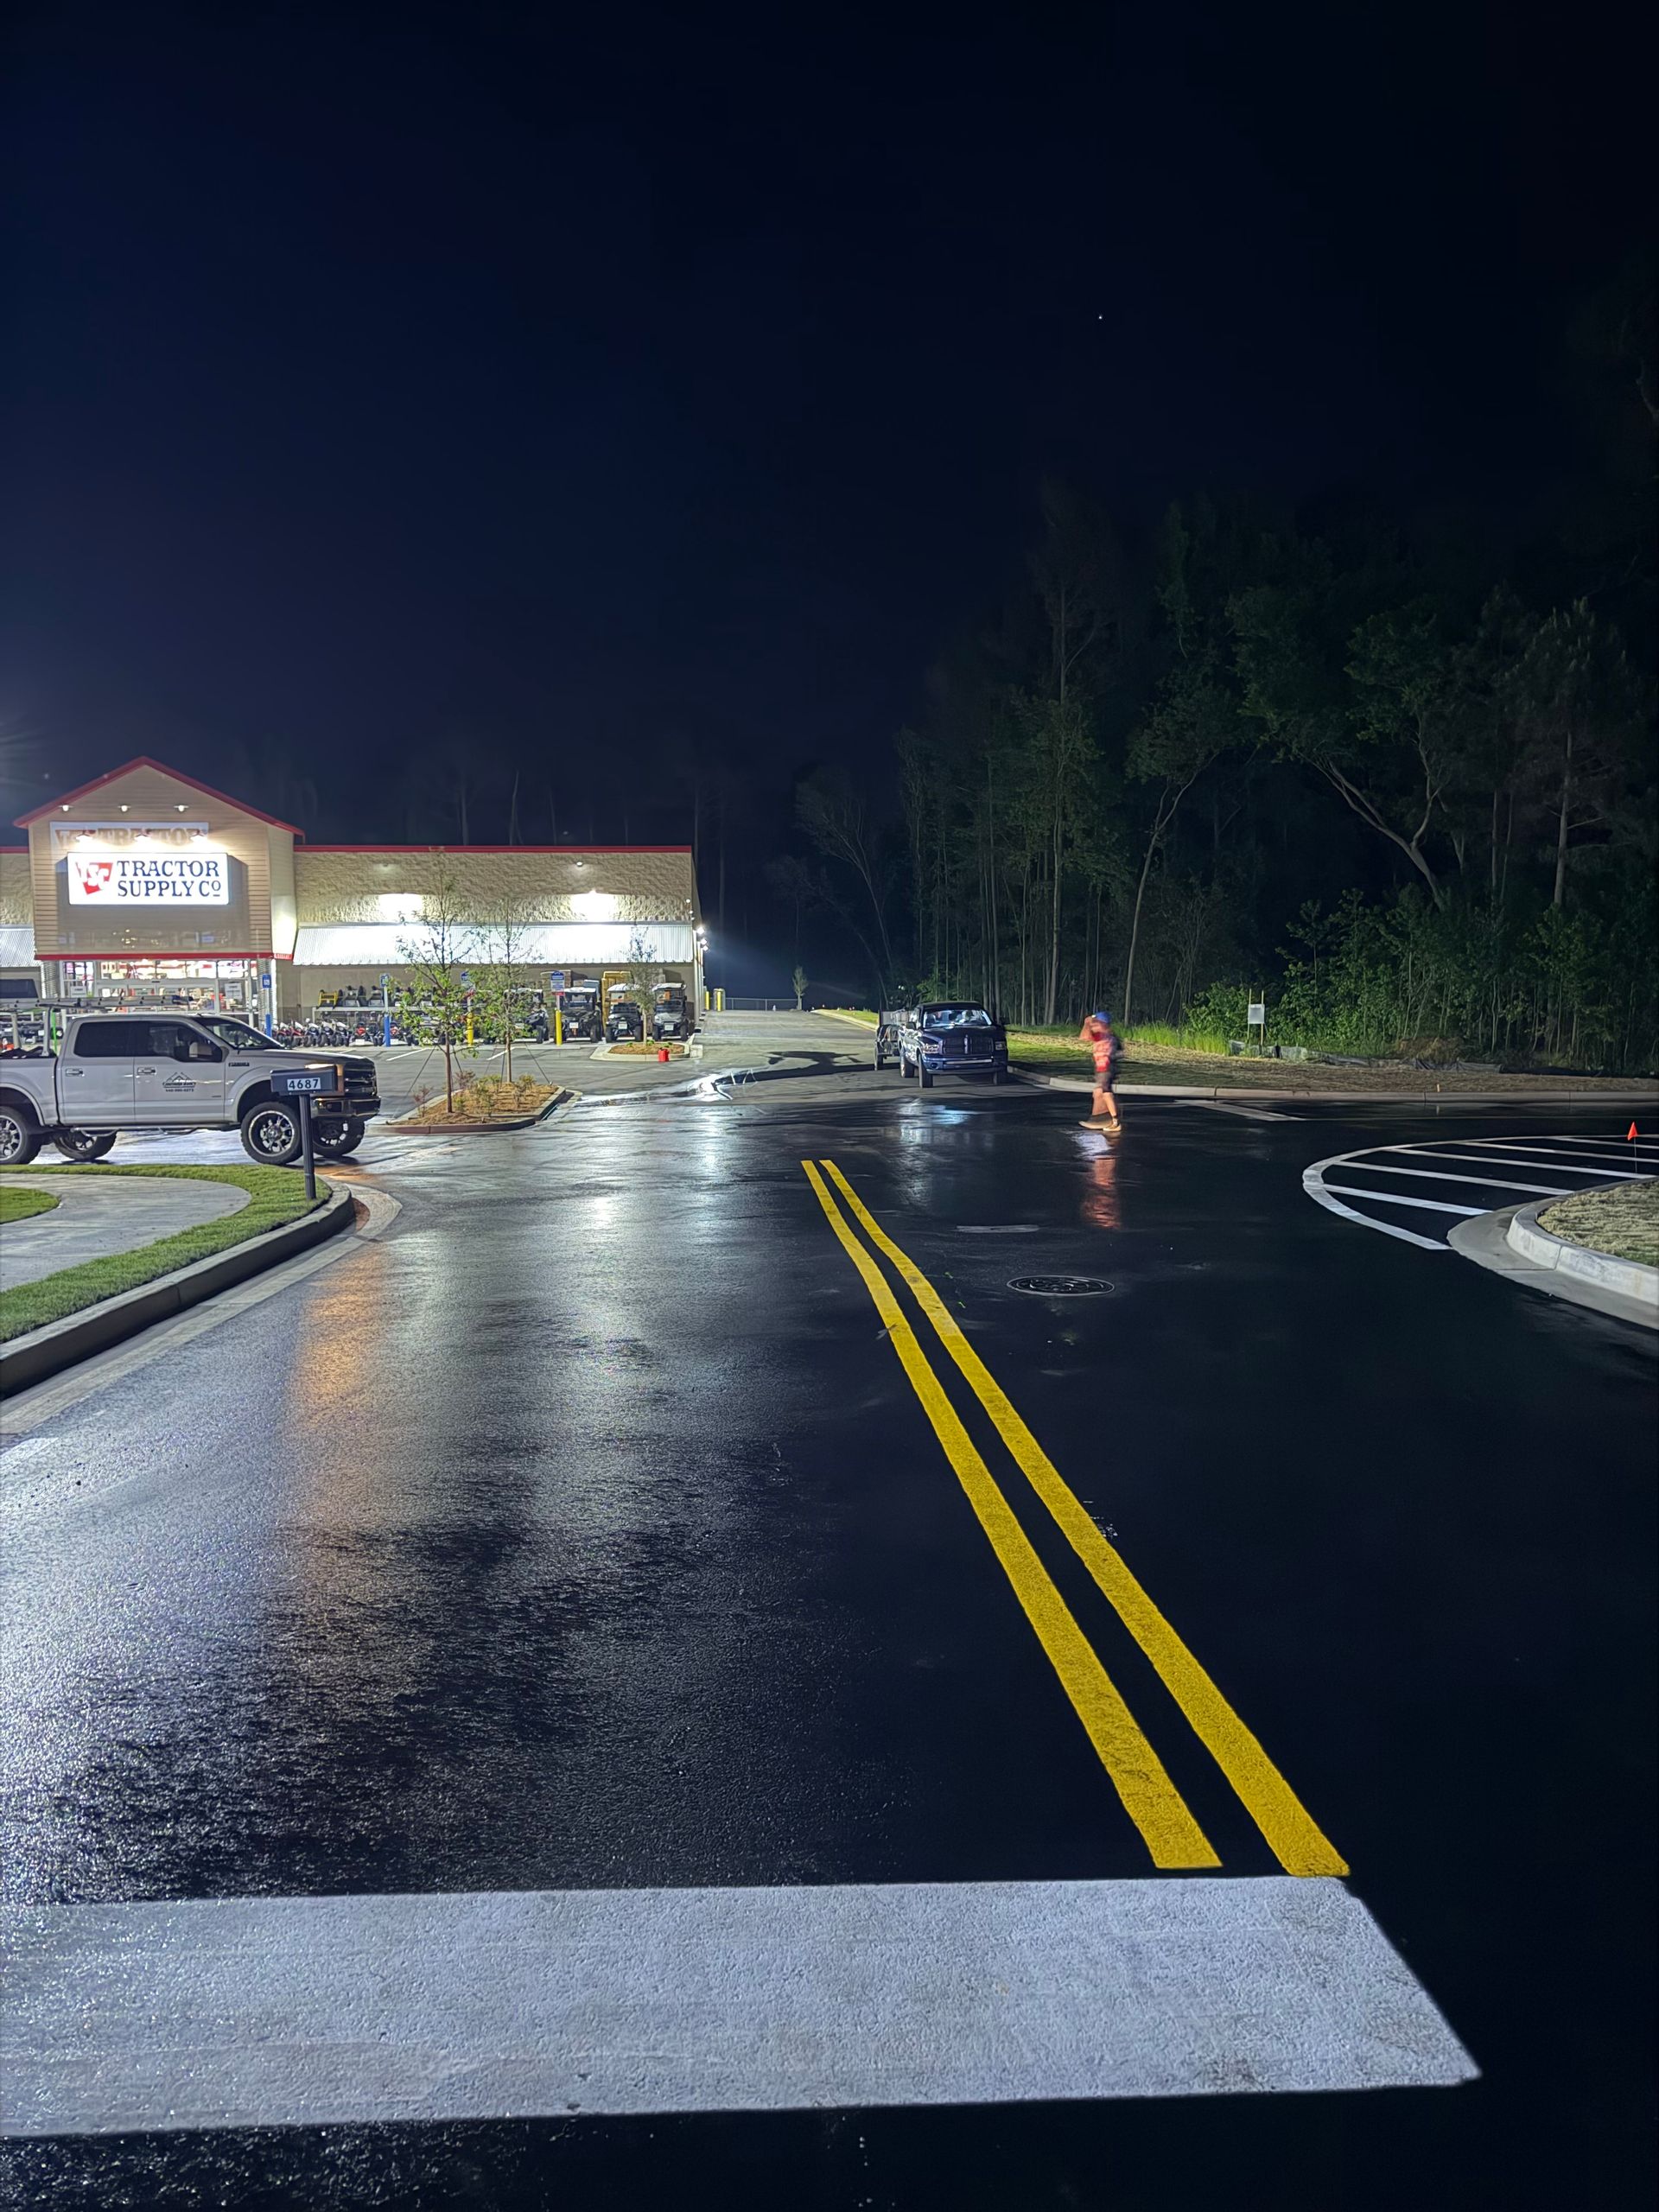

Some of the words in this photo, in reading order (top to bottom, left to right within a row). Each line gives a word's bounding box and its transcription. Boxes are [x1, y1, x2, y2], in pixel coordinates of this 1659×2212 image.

[117, 861, 219, 877] TRACTOR
[118, 880, 194, 897] SUPPLY
[288, 1078, 319, 1090] 4687
